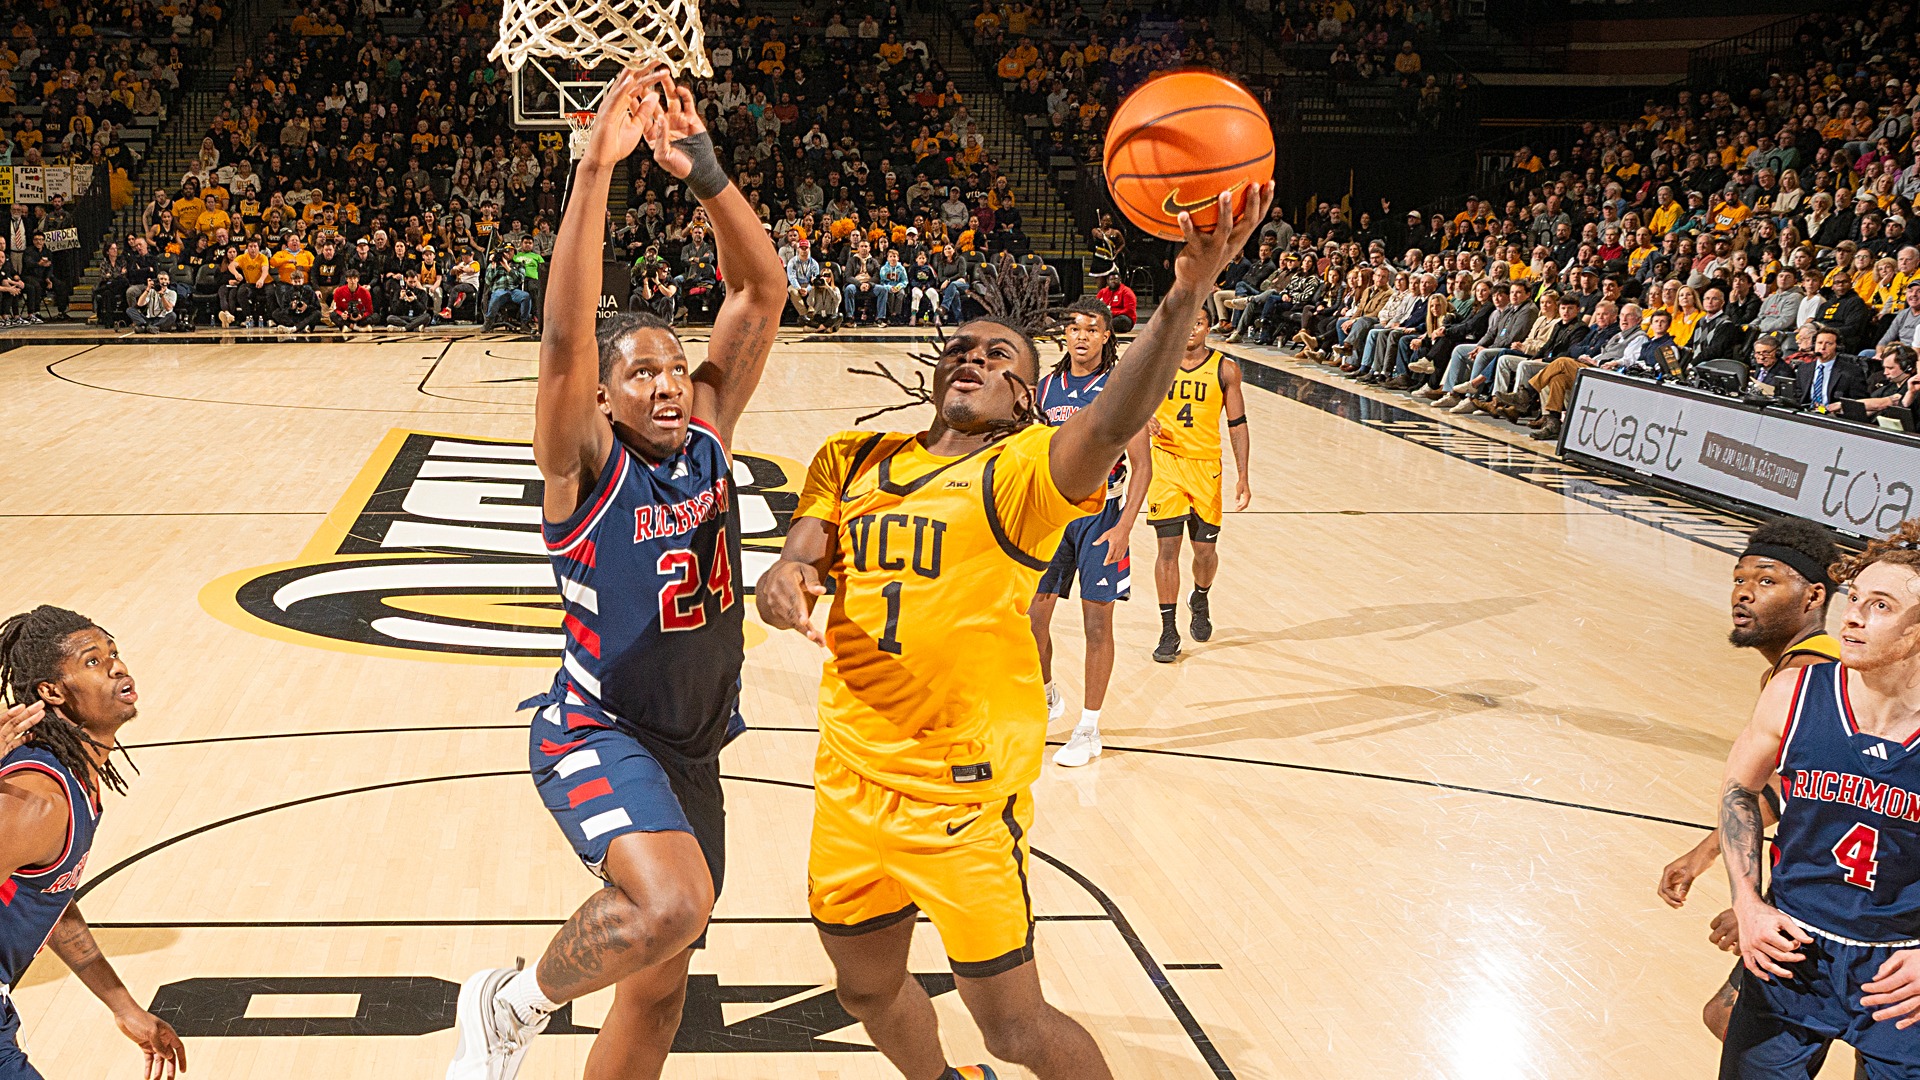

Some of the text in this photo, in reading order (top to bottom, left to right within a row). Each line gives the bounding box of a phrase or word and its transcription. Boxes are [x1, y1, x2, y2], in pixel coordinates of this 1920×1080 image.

[20, 182, 44, 193] LEWIS
[45, 229, 77, 243] BURDEN
[1177, 403, 1193, 427] 4
[1578, 390, 1688, 472] toast
[656, 527, 735, 633] 24
[848, 513, 948, 580] VCU
[878, 580, 903, 656] 1
[981, 767, 987, 776] L
[1831, 822, 1879, 892] 4
